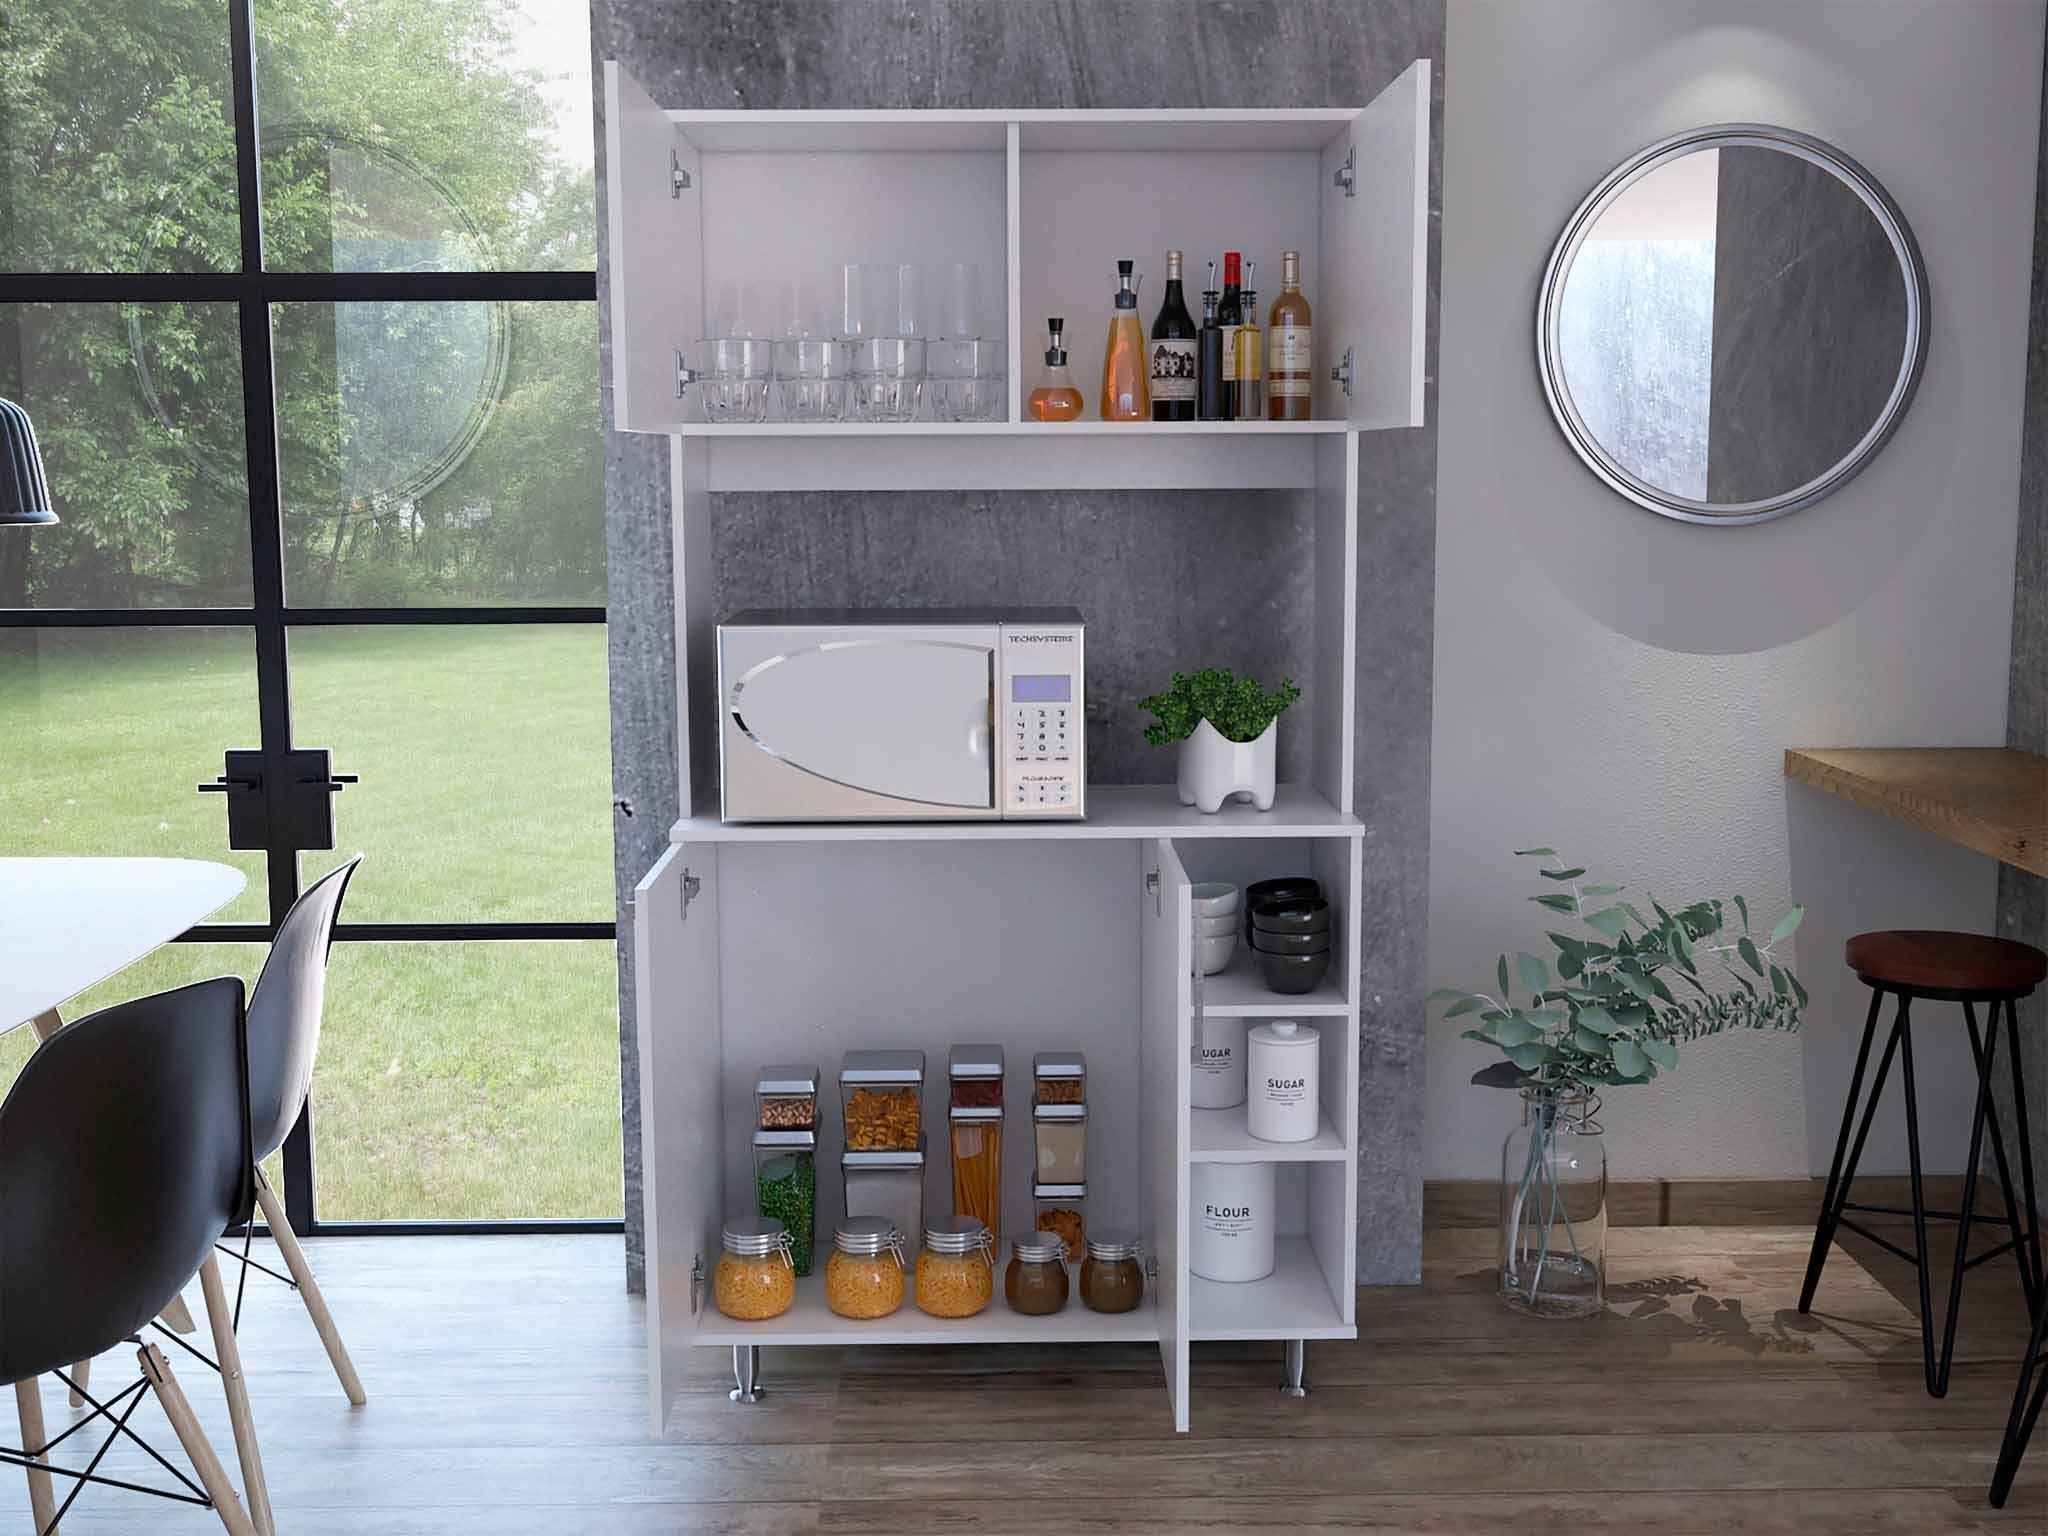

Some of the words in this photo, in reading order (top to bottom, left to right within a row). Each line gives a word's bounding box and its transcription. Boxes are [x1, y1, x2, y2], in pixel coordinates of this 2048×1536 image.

[1202, 1048, 1232, 1058] UGAR
[1267, 1079, 1305, 1089] SUGAR
[1206, 1205, 1250, 1218] FLOUR
